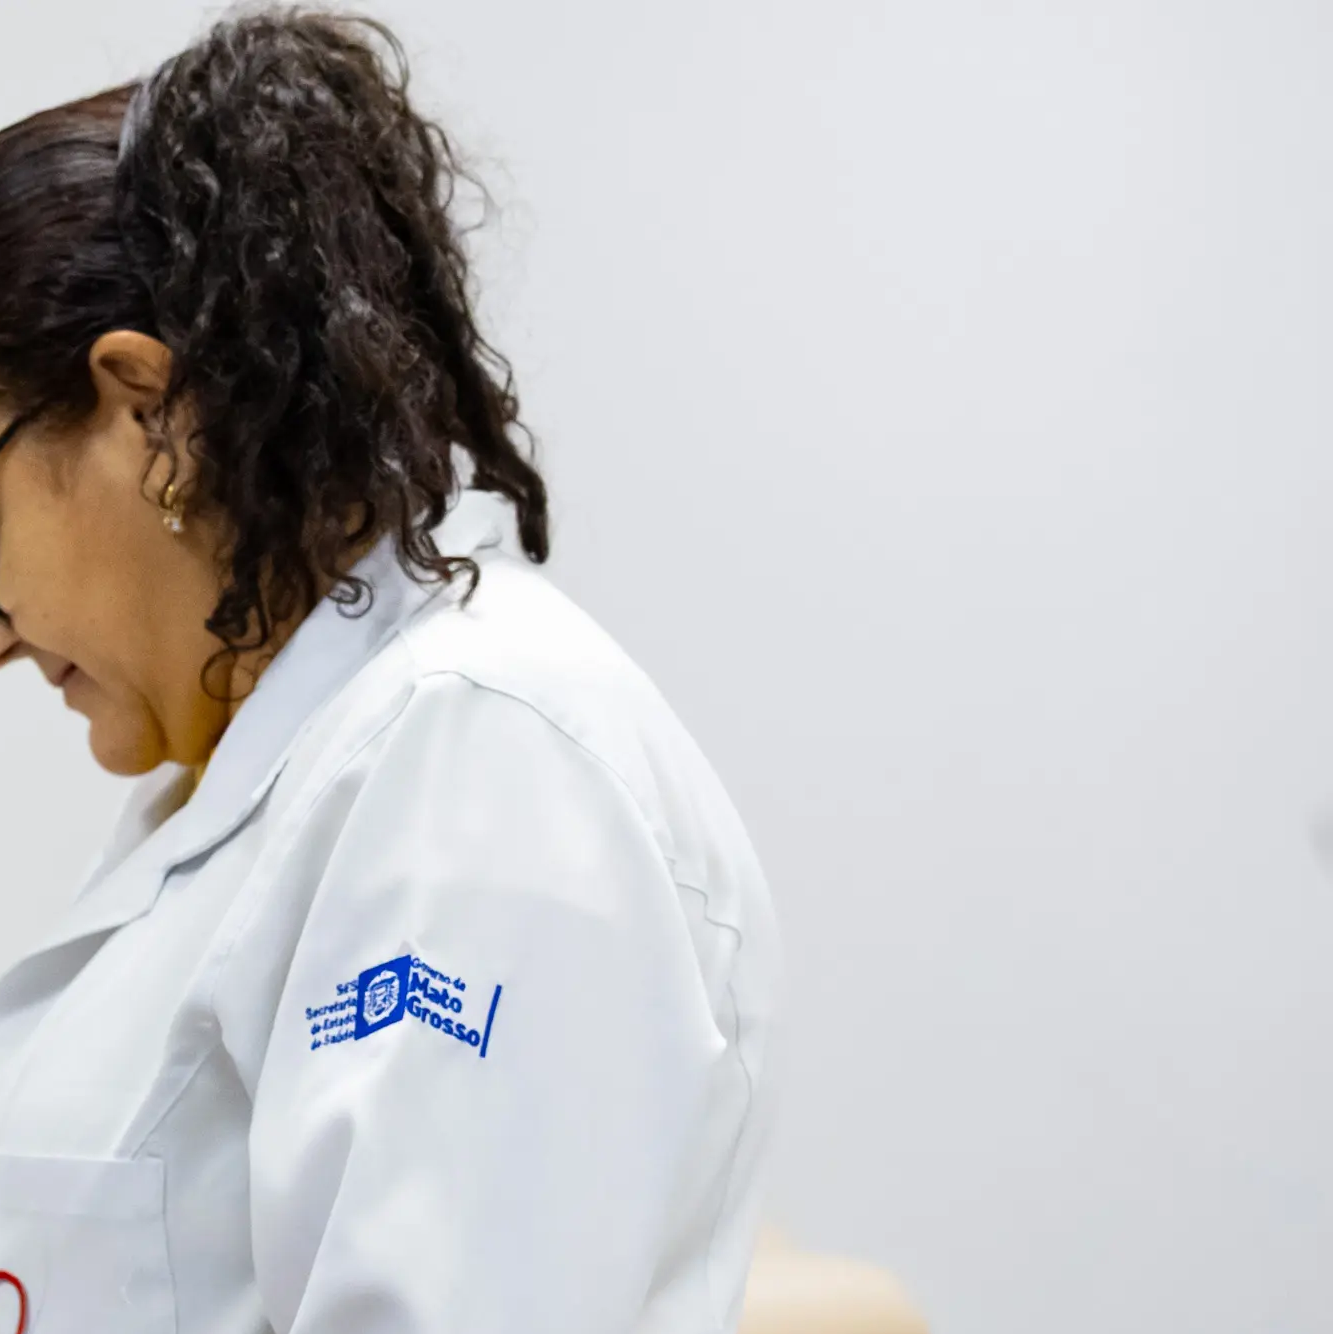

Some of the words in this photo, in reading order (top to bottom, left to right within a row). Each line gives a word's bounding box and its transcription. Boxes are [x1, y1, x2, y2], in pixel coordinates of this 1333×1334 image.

[305, 997, 358, 1020] Secretaria
[409, 972, 462, 1013] Mato
[323, 1014, 357, 1030] Estado
[406, 995, 480, 1047] Grosso
